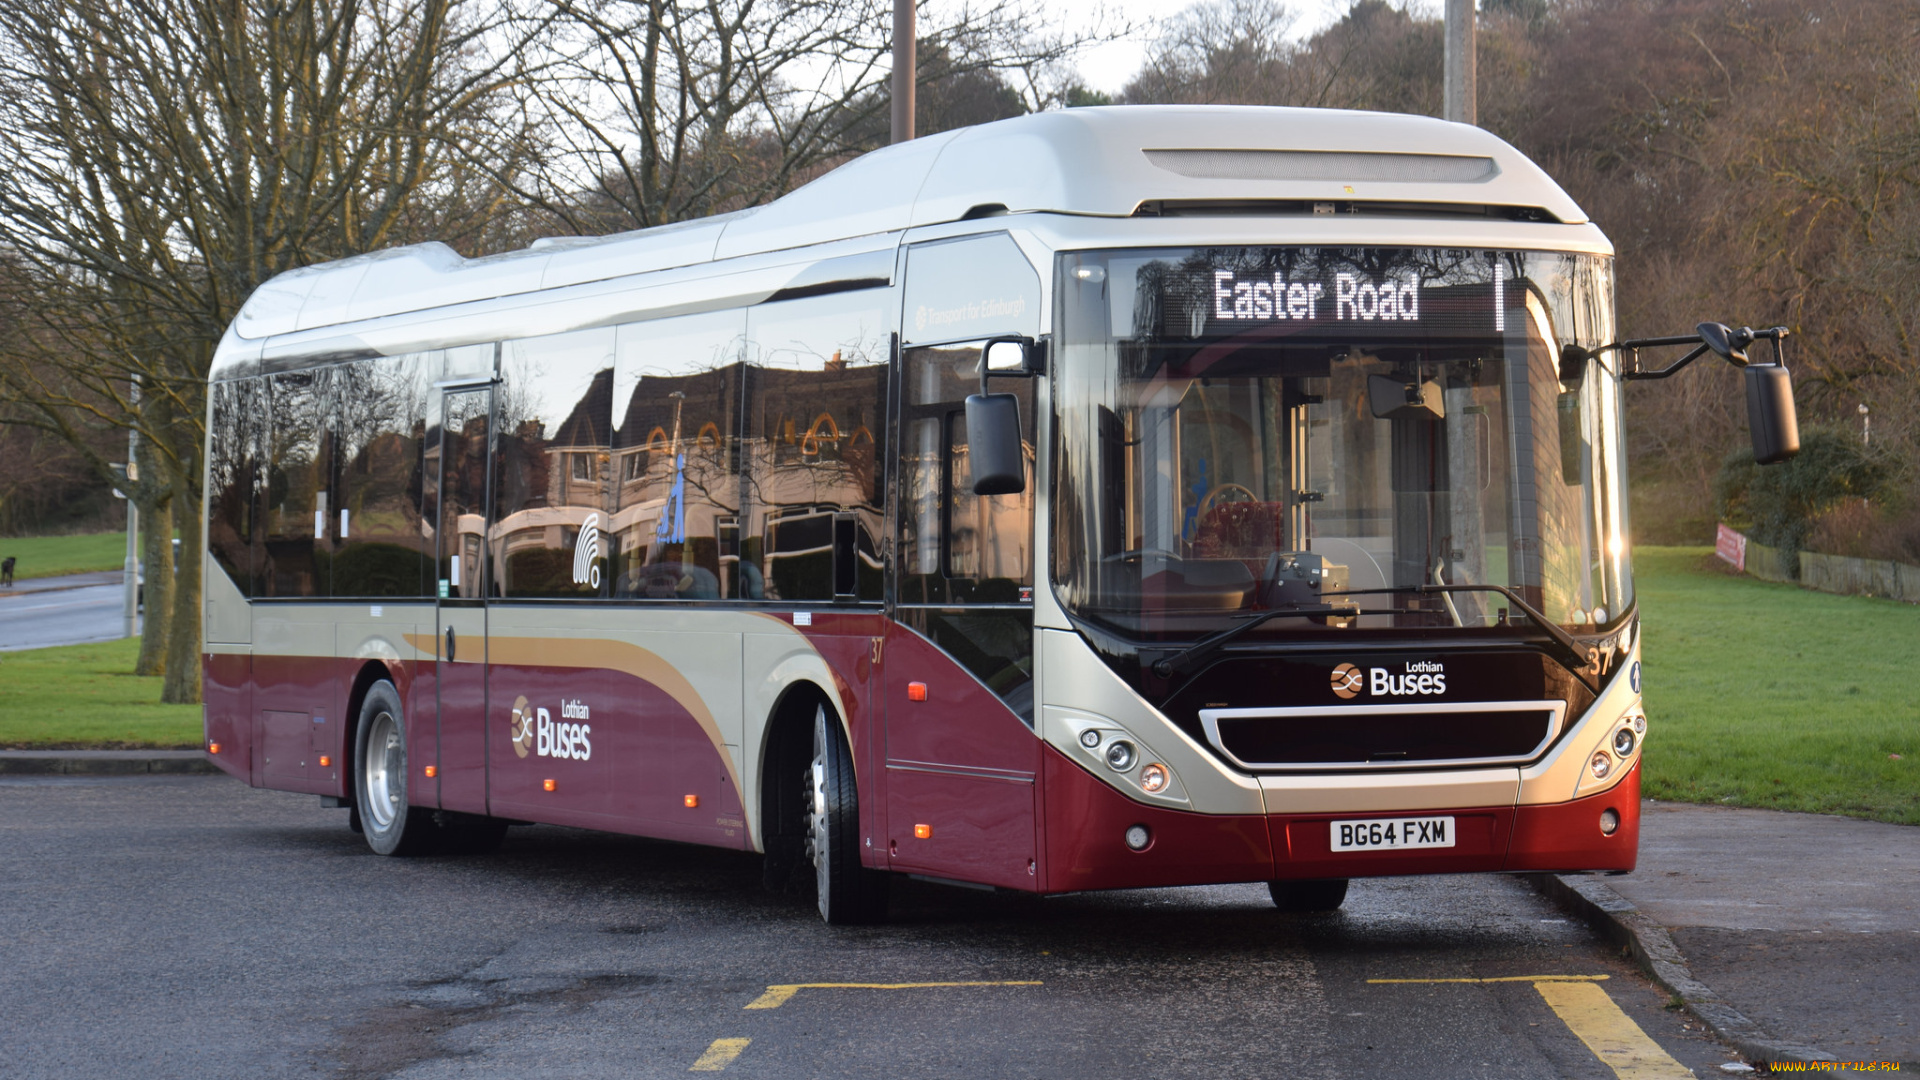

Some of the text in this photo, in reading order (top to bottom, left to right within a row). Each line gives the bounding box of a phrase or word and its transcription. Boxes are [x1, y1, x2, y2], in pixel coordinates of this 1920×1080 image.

[928, 295, 1025, 326] Transport for Edinburgh
[1214, 271, 1322, 320] Easter
[1336, 272, 1419, 321] Road
[872, 637, 883, 664] 37
[1588, 647, 1611, 676] 37
[1370, 667, 1446, 696] Buses
[1406, 661, 1443, 673] Lothian
[561, 699, 589, 720] Lothian
[537, 708, 591, 761] Buses
[1340, 820, 1445, 847] BG64 FXM
